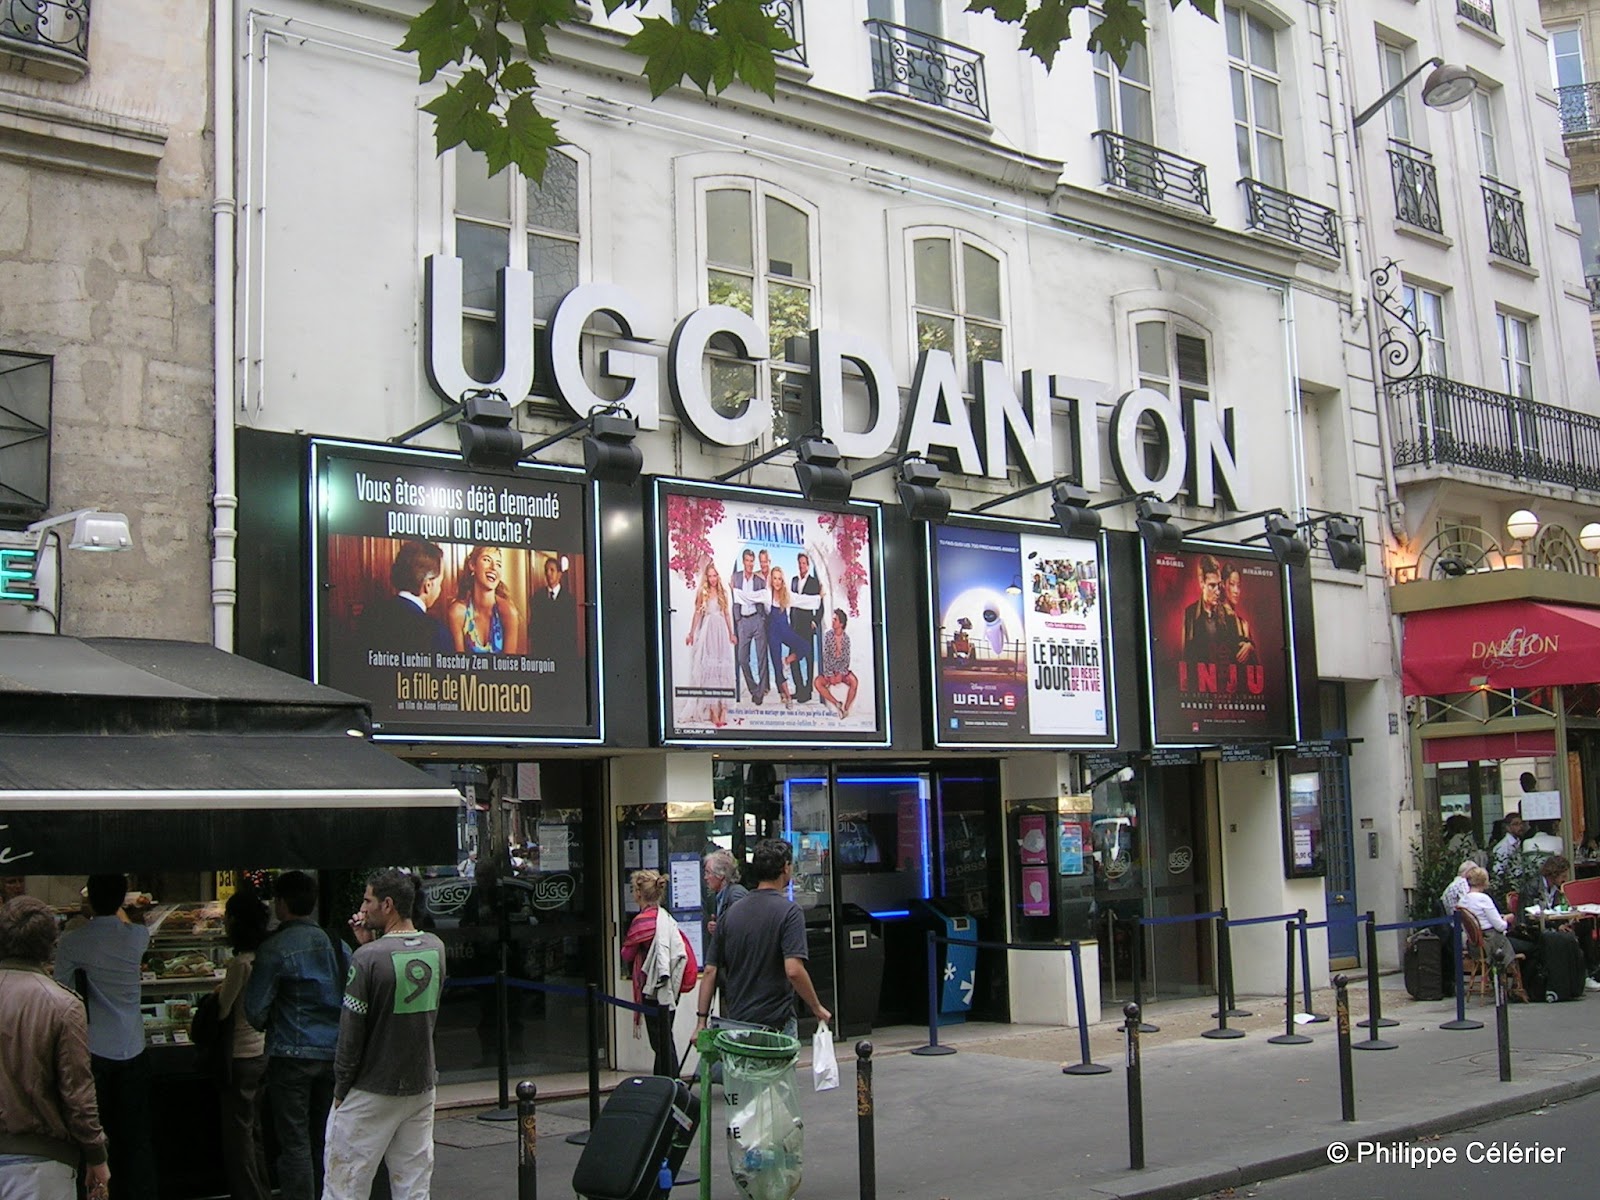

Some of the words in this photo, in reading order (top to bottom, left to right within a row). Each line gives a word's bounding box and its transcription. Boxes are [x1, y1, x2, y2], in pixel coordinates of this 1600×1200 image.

[425, 254, 775, 446] UGC
[810, 328, 1248, 512] DANTON
[355, 472, 391, 504] Vous
[467, 485, 496, 516] déjà
[499, 488, 560, 519] demandé
[387, 510, 450, 539] pourquoi
[453, 517, 471, 539] on
[474, 516, 522, 543] couche
[524, 518, 532, 544] ?
[737, 518, 779, 543] MAMMA
[781, 522, 805, 545] MIA!
[1033, 643, 1047, 665] LE
[1049, 644, 1099, 667] PREMIER
[1472, 634, 1560, 659] DANTON
[368, 650, 400, 667] Fabrice
[401, 652, 432, 668] Luchini
[436, 653, 470, 671] Roschdy
[472, 655, 489, 670] Zem
[493, 656, 519, 671] Louise
[520, 657, 556, 674] Bourgoin
[1034, 665, 1071, 691] JOUR
[1071, 667, 1080, 679] DU
[1081, 667, 1100, 680] RESTE
[1071, 679, 1080, 692] DE
[1081, 679, 1090, 692] TA
[1091, 680, 1101, 692] VIE
[1178, 661, 1264, 695] INJU
[397, 671, 410, 700] la
[413, 672, 439, 700] fille
[442, 673, 459, 701] de
[460, 673, 531, 713] Monaco
[429, 886, 466, 904] UGC
[535, 882, 570, 900] UGC
[404, 958, 433, 1004] 9
